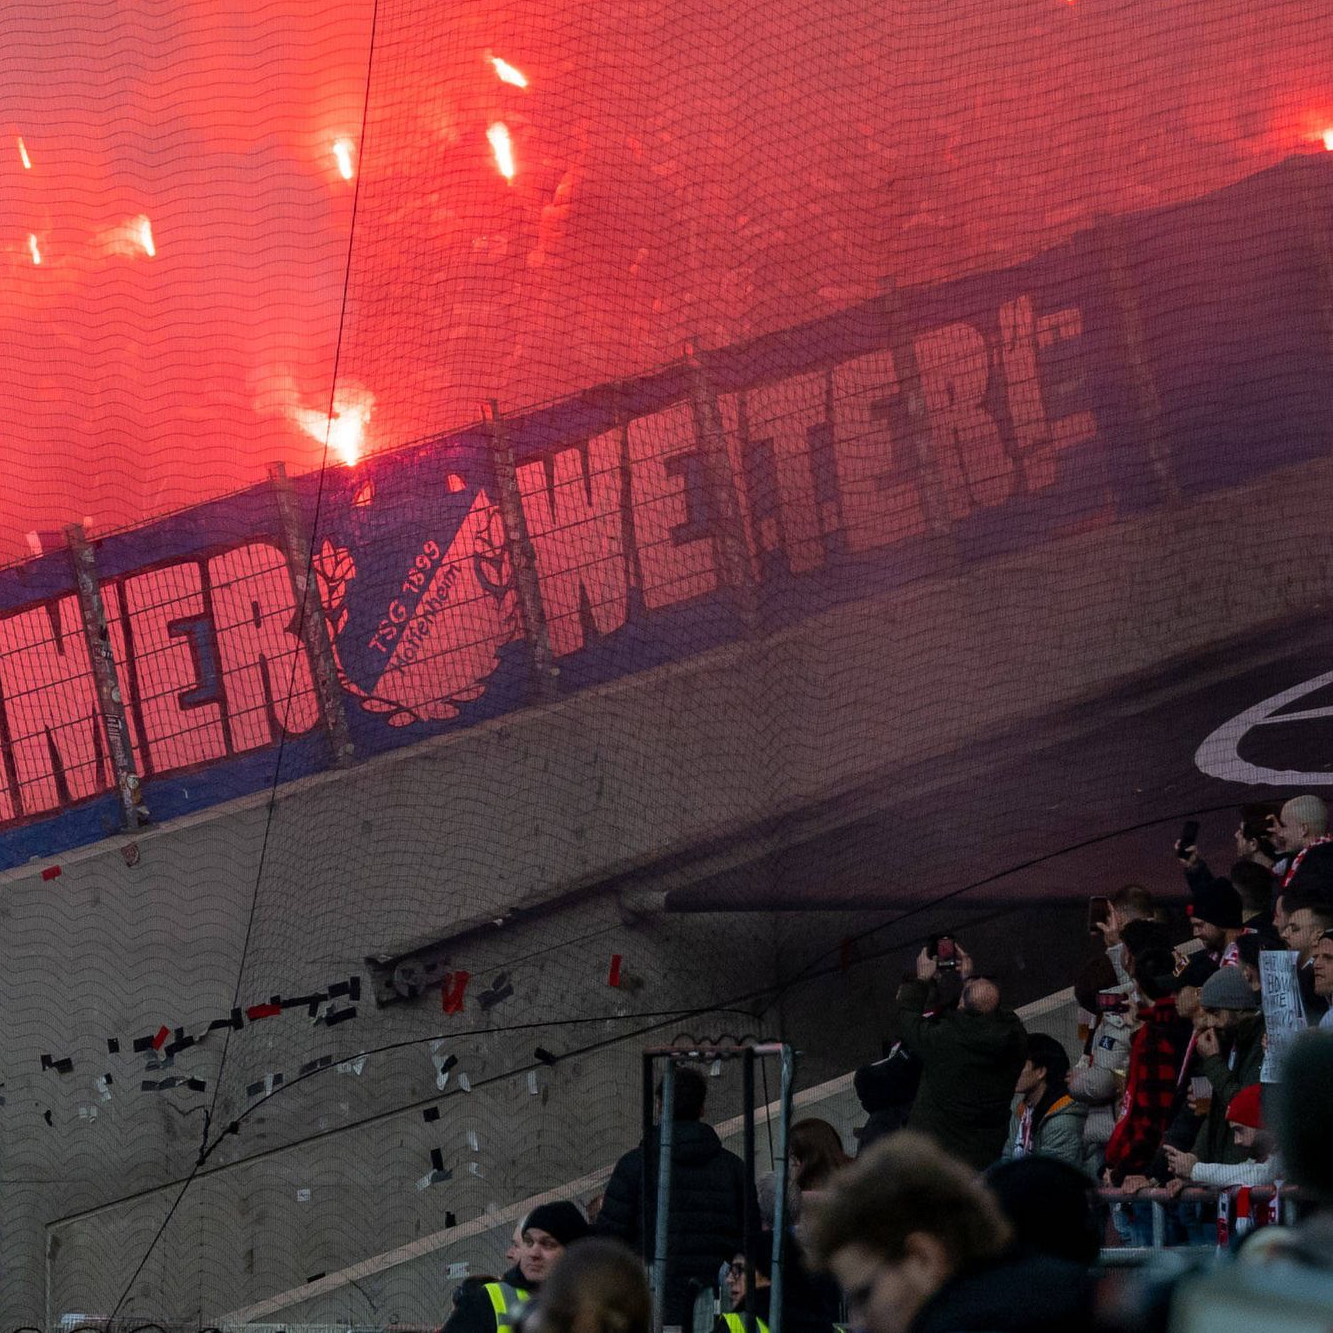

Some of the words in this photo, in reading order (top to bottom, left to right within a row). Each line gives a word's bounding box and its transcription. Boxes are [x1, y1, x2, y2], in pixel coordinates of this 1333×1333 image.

[515, 292, 1057, 660] WEITER!
[369, 599, 406, 653] TSG
[402, 540, 441, 594] 1899
